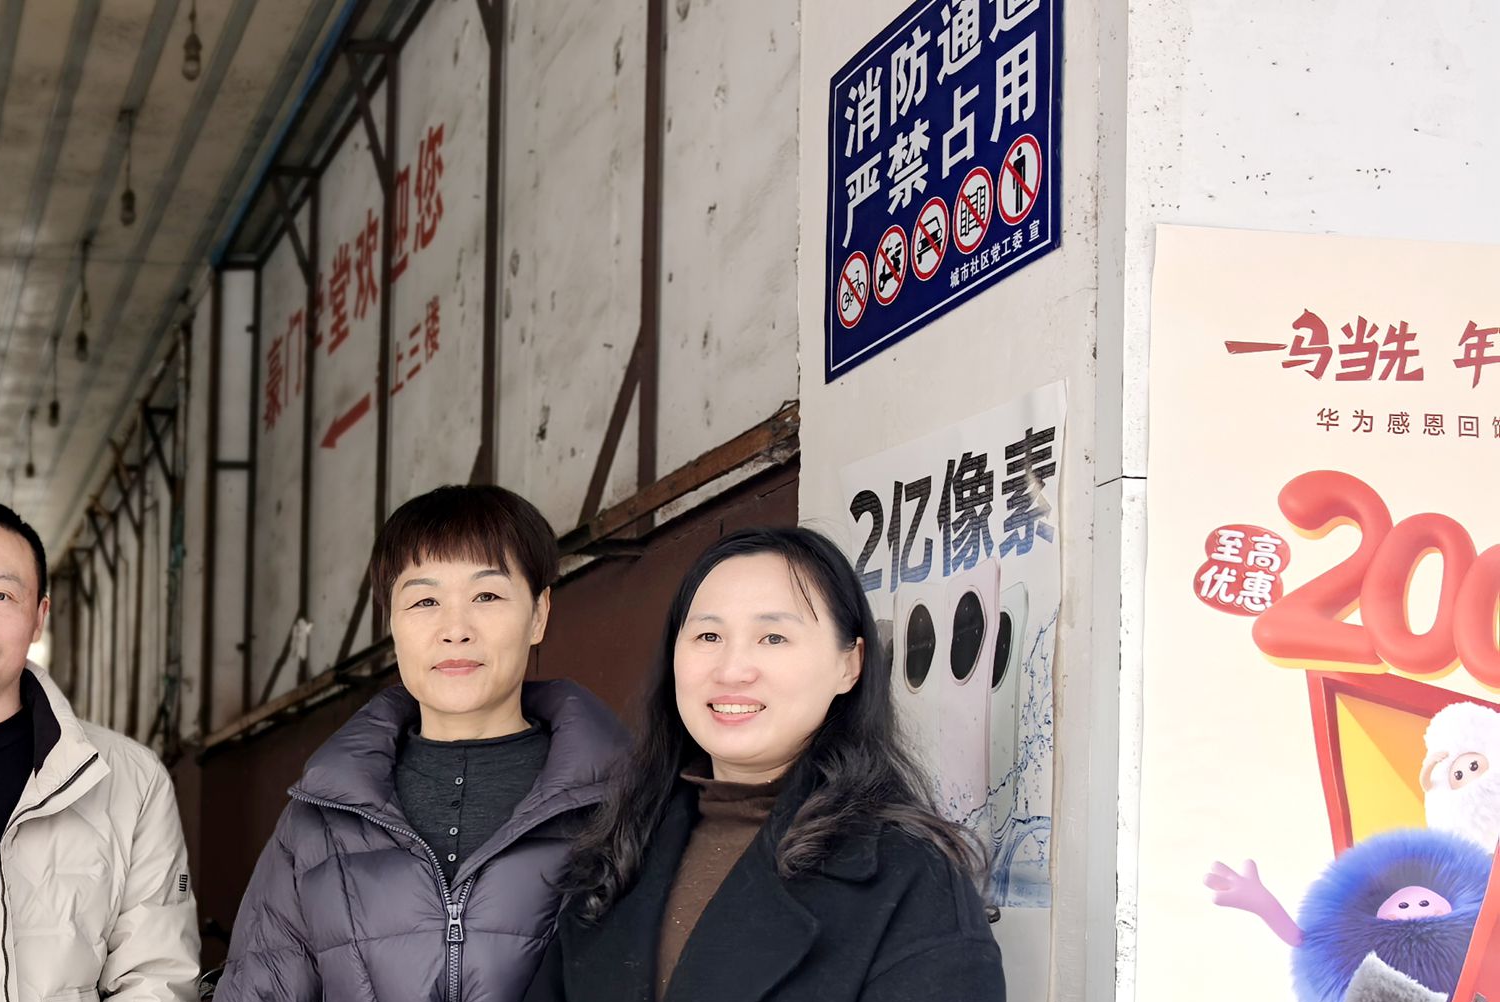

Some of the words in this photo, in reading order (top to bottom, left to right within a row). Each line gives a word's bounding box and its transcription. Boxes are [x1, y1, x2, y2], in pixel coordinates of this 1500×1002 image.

[842, 31, 1037, 248] 严禁占用
[1028, 219, 1041, 243] 宣
[1224, 308, 1424, 382] 一马当先
[849, 426, 1057, 593] 2亿像素
[1211, 529, 1282, 573] 至高
[1200, 565, 1277, 613] 优惠
